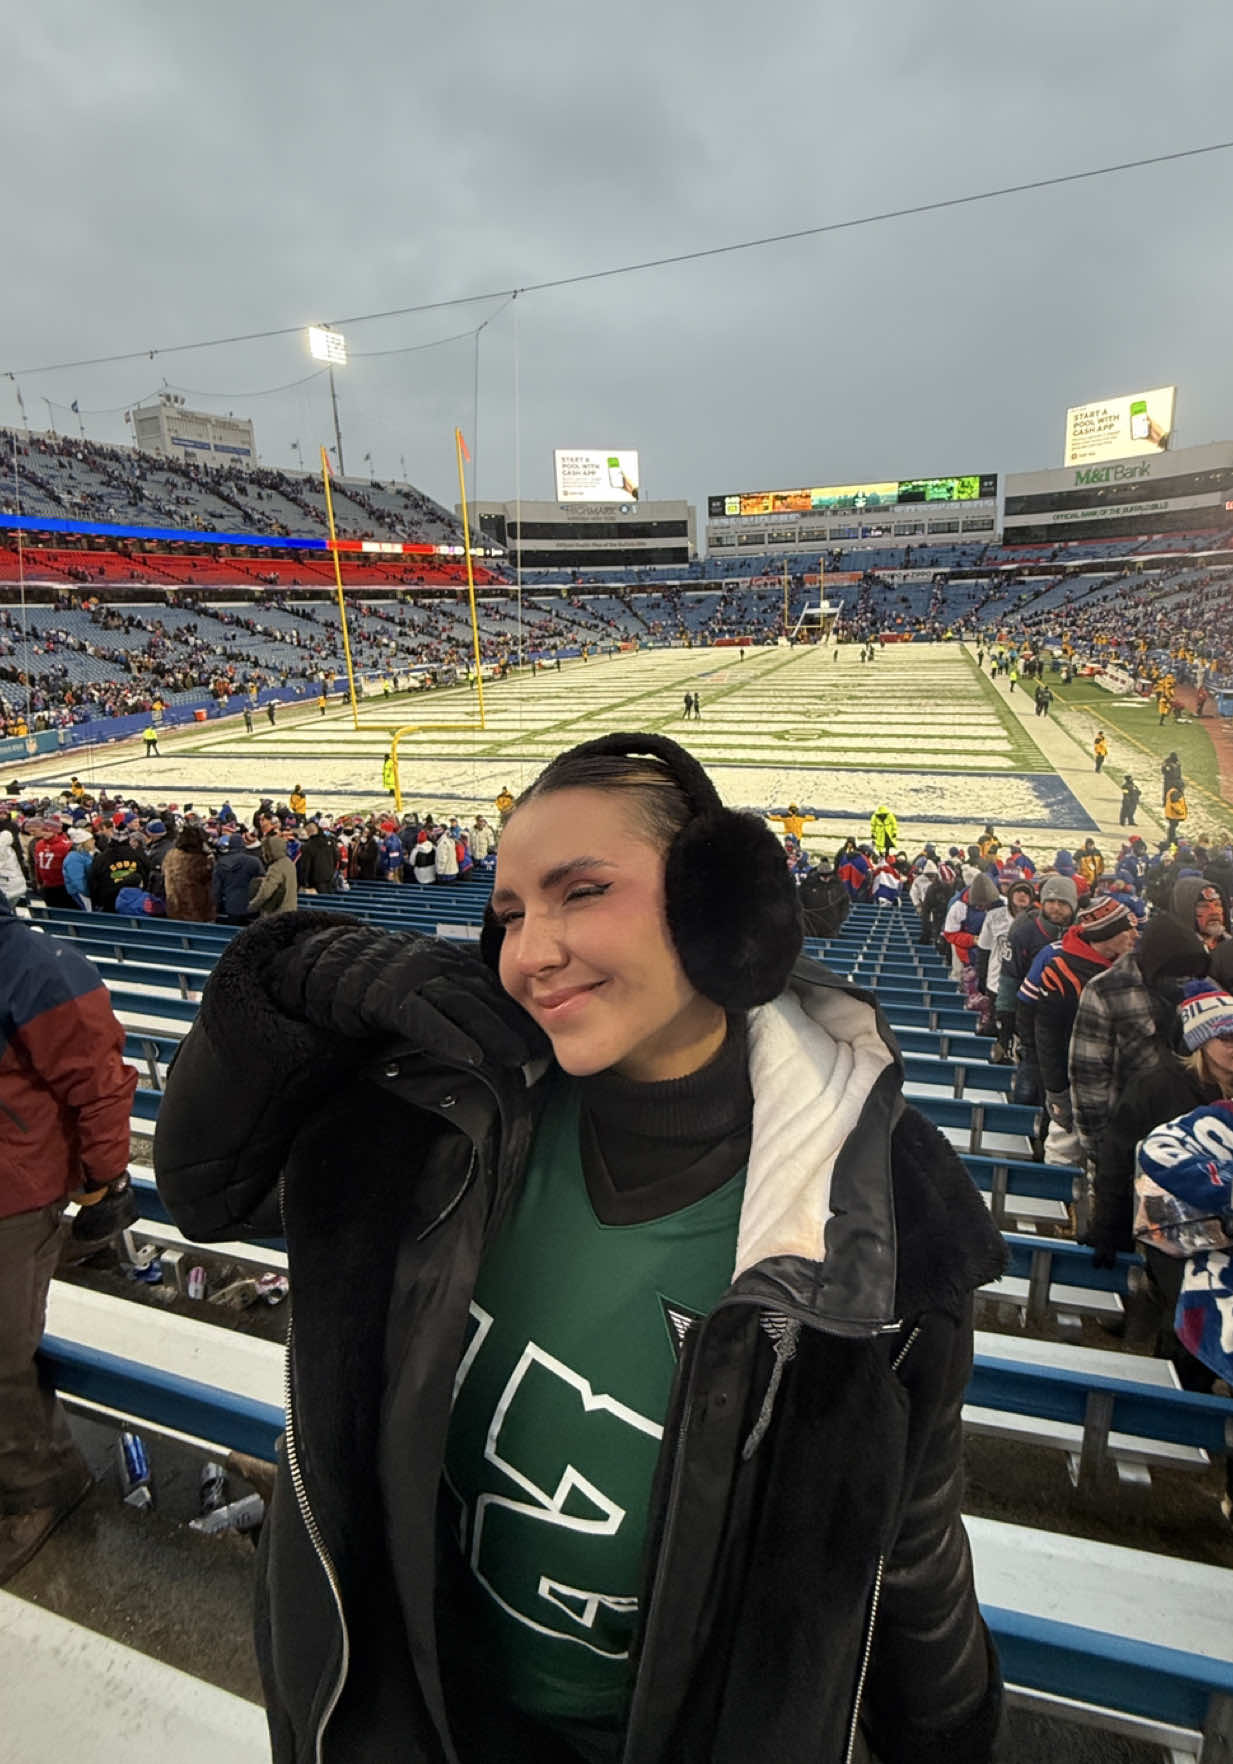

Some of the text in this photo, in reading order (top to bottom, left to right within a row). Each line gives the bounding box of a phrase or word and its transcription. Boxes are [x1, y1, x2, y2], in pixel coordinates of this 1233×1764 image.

[1073, 409, 1101, 421] START
[1073, 414, 1120, 429] POOL WITH
[1072, 423, 1115, 437] CASH APP
[1113, 460, 1151, 481] Bank
[38, 851, 55, 870] 17
